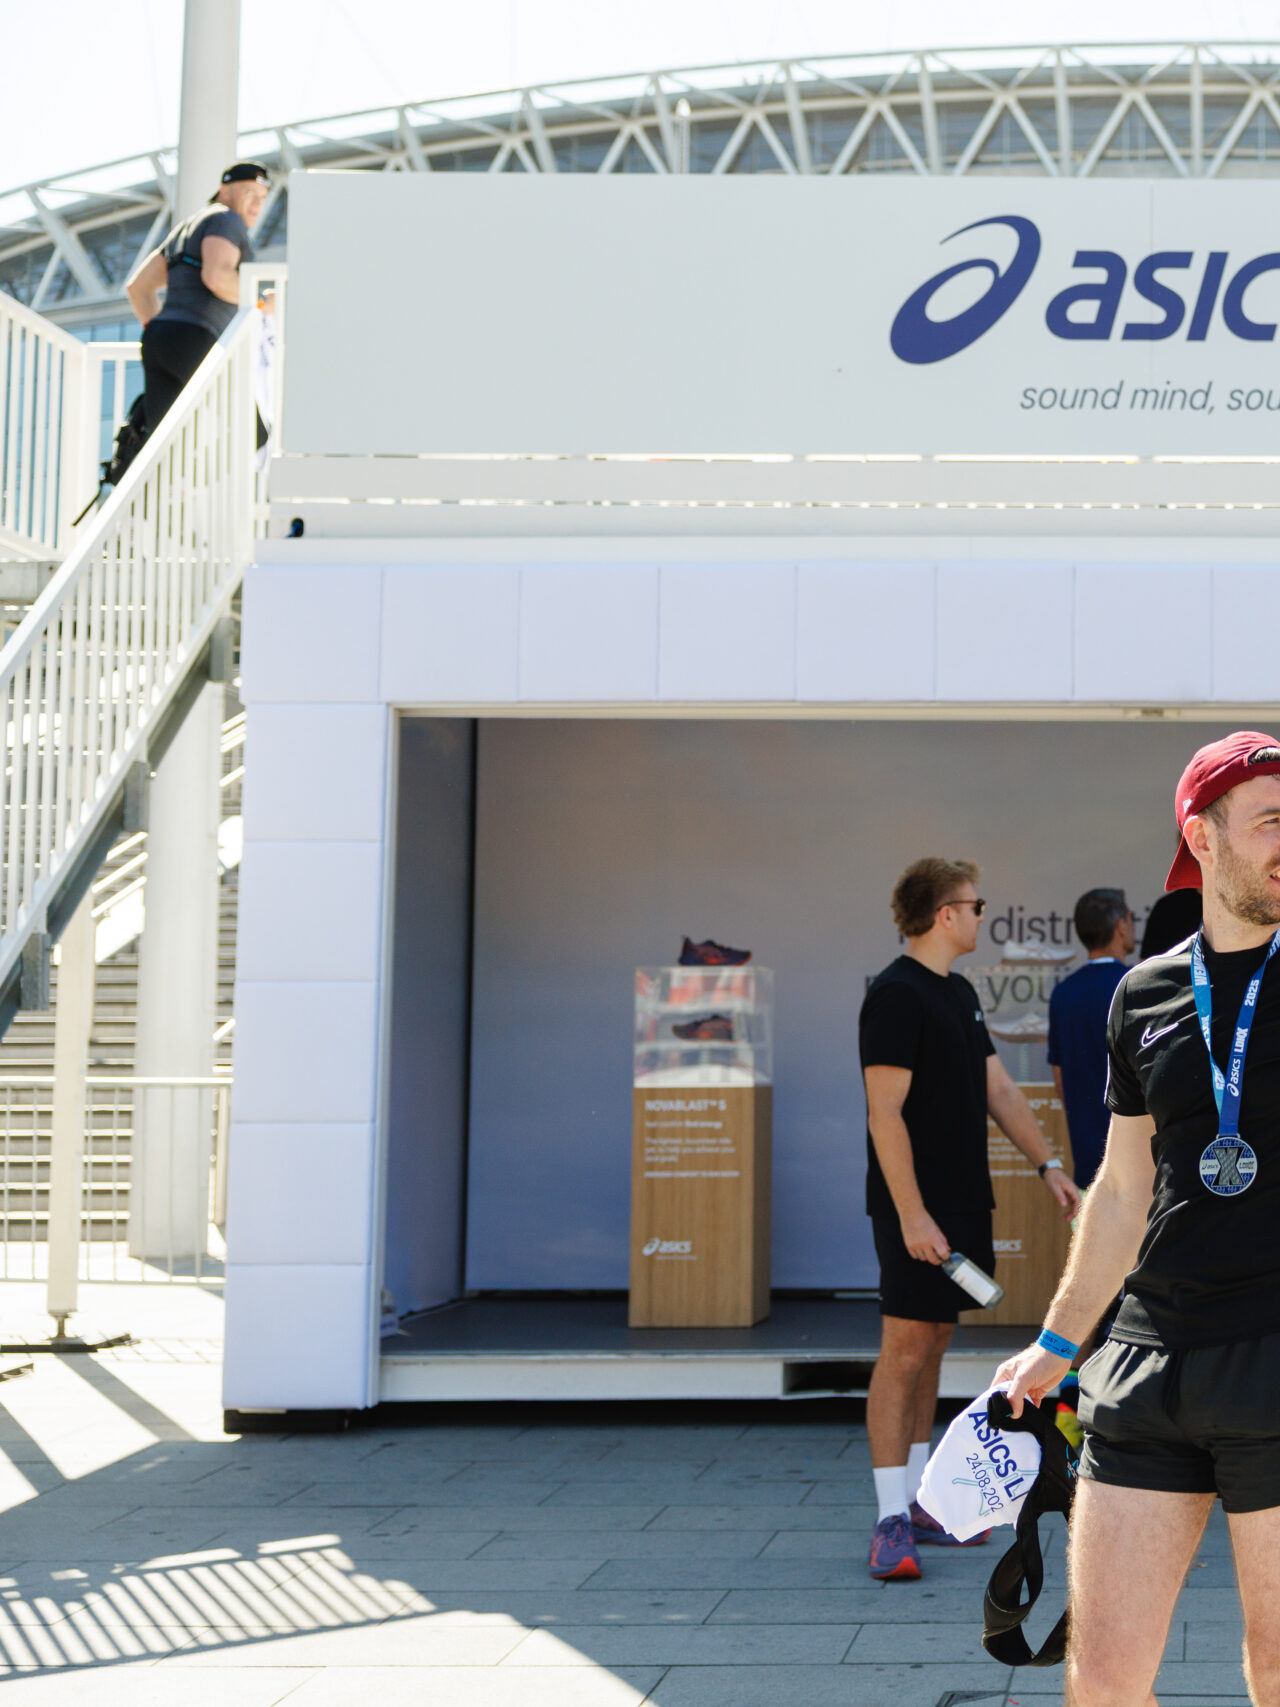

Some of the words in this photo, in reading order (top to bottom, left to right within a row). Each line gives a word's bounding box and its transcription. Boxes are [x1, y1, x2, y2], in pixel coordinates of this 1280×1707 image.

[1019, 380, 1124, 411] sound
[1130, 380, 1215, 414] mind,
[1244, 979, 1260, 1007] 2025
[968, 1411, 1017, 1479] ASICS
[966, 1453, 1004, 1513] 24.08.202
